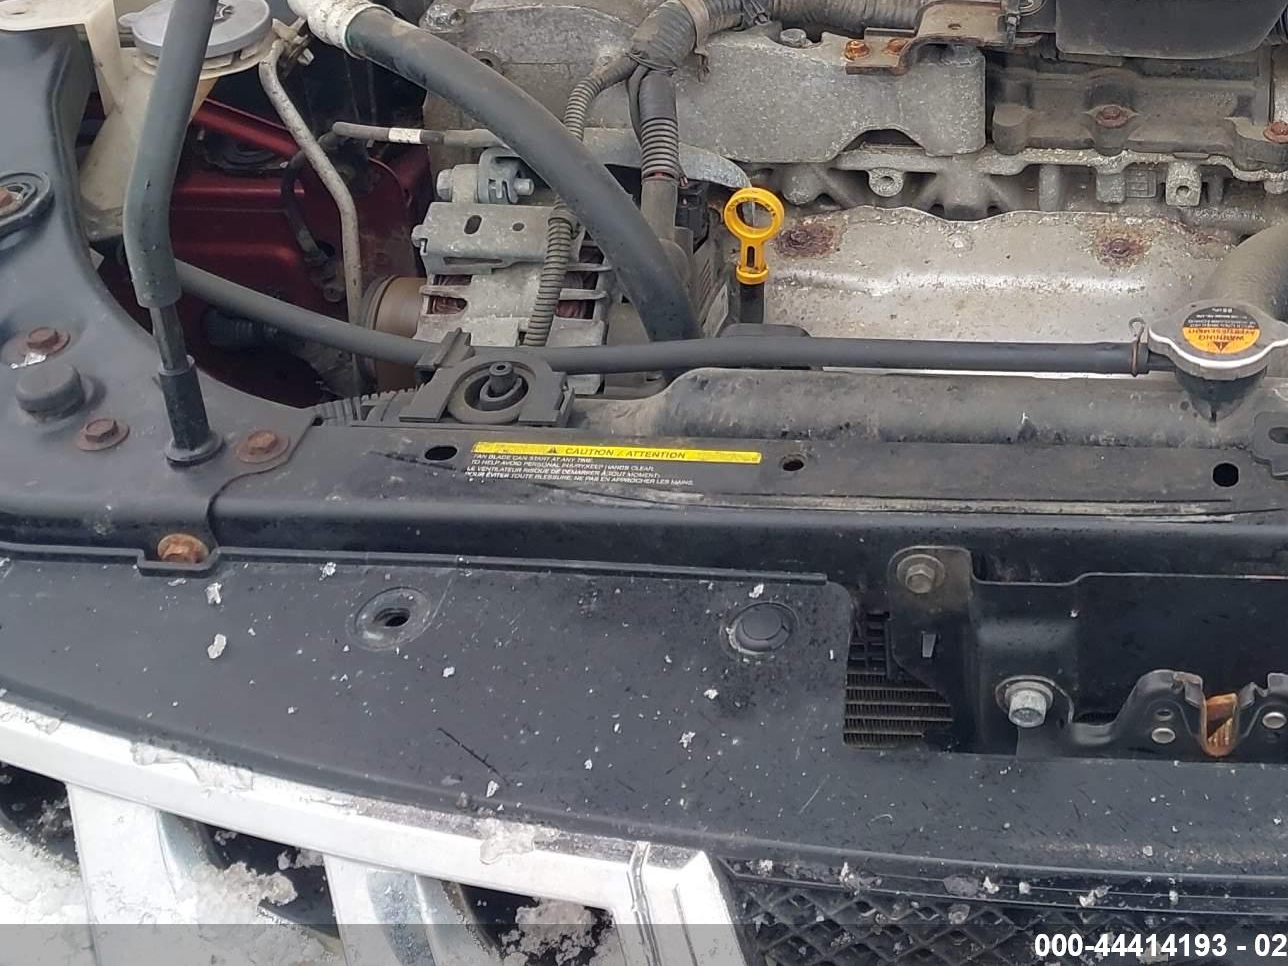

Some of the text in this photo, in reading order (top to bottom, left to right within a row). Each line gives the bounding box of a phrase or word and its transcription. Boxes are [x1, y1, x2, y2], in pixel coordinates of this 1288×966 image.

[1198, 334, 1244, 342] WARNING
[565, 447, 614, 456] CAUTION
[624, 450, 686, 459] ATTENTION
